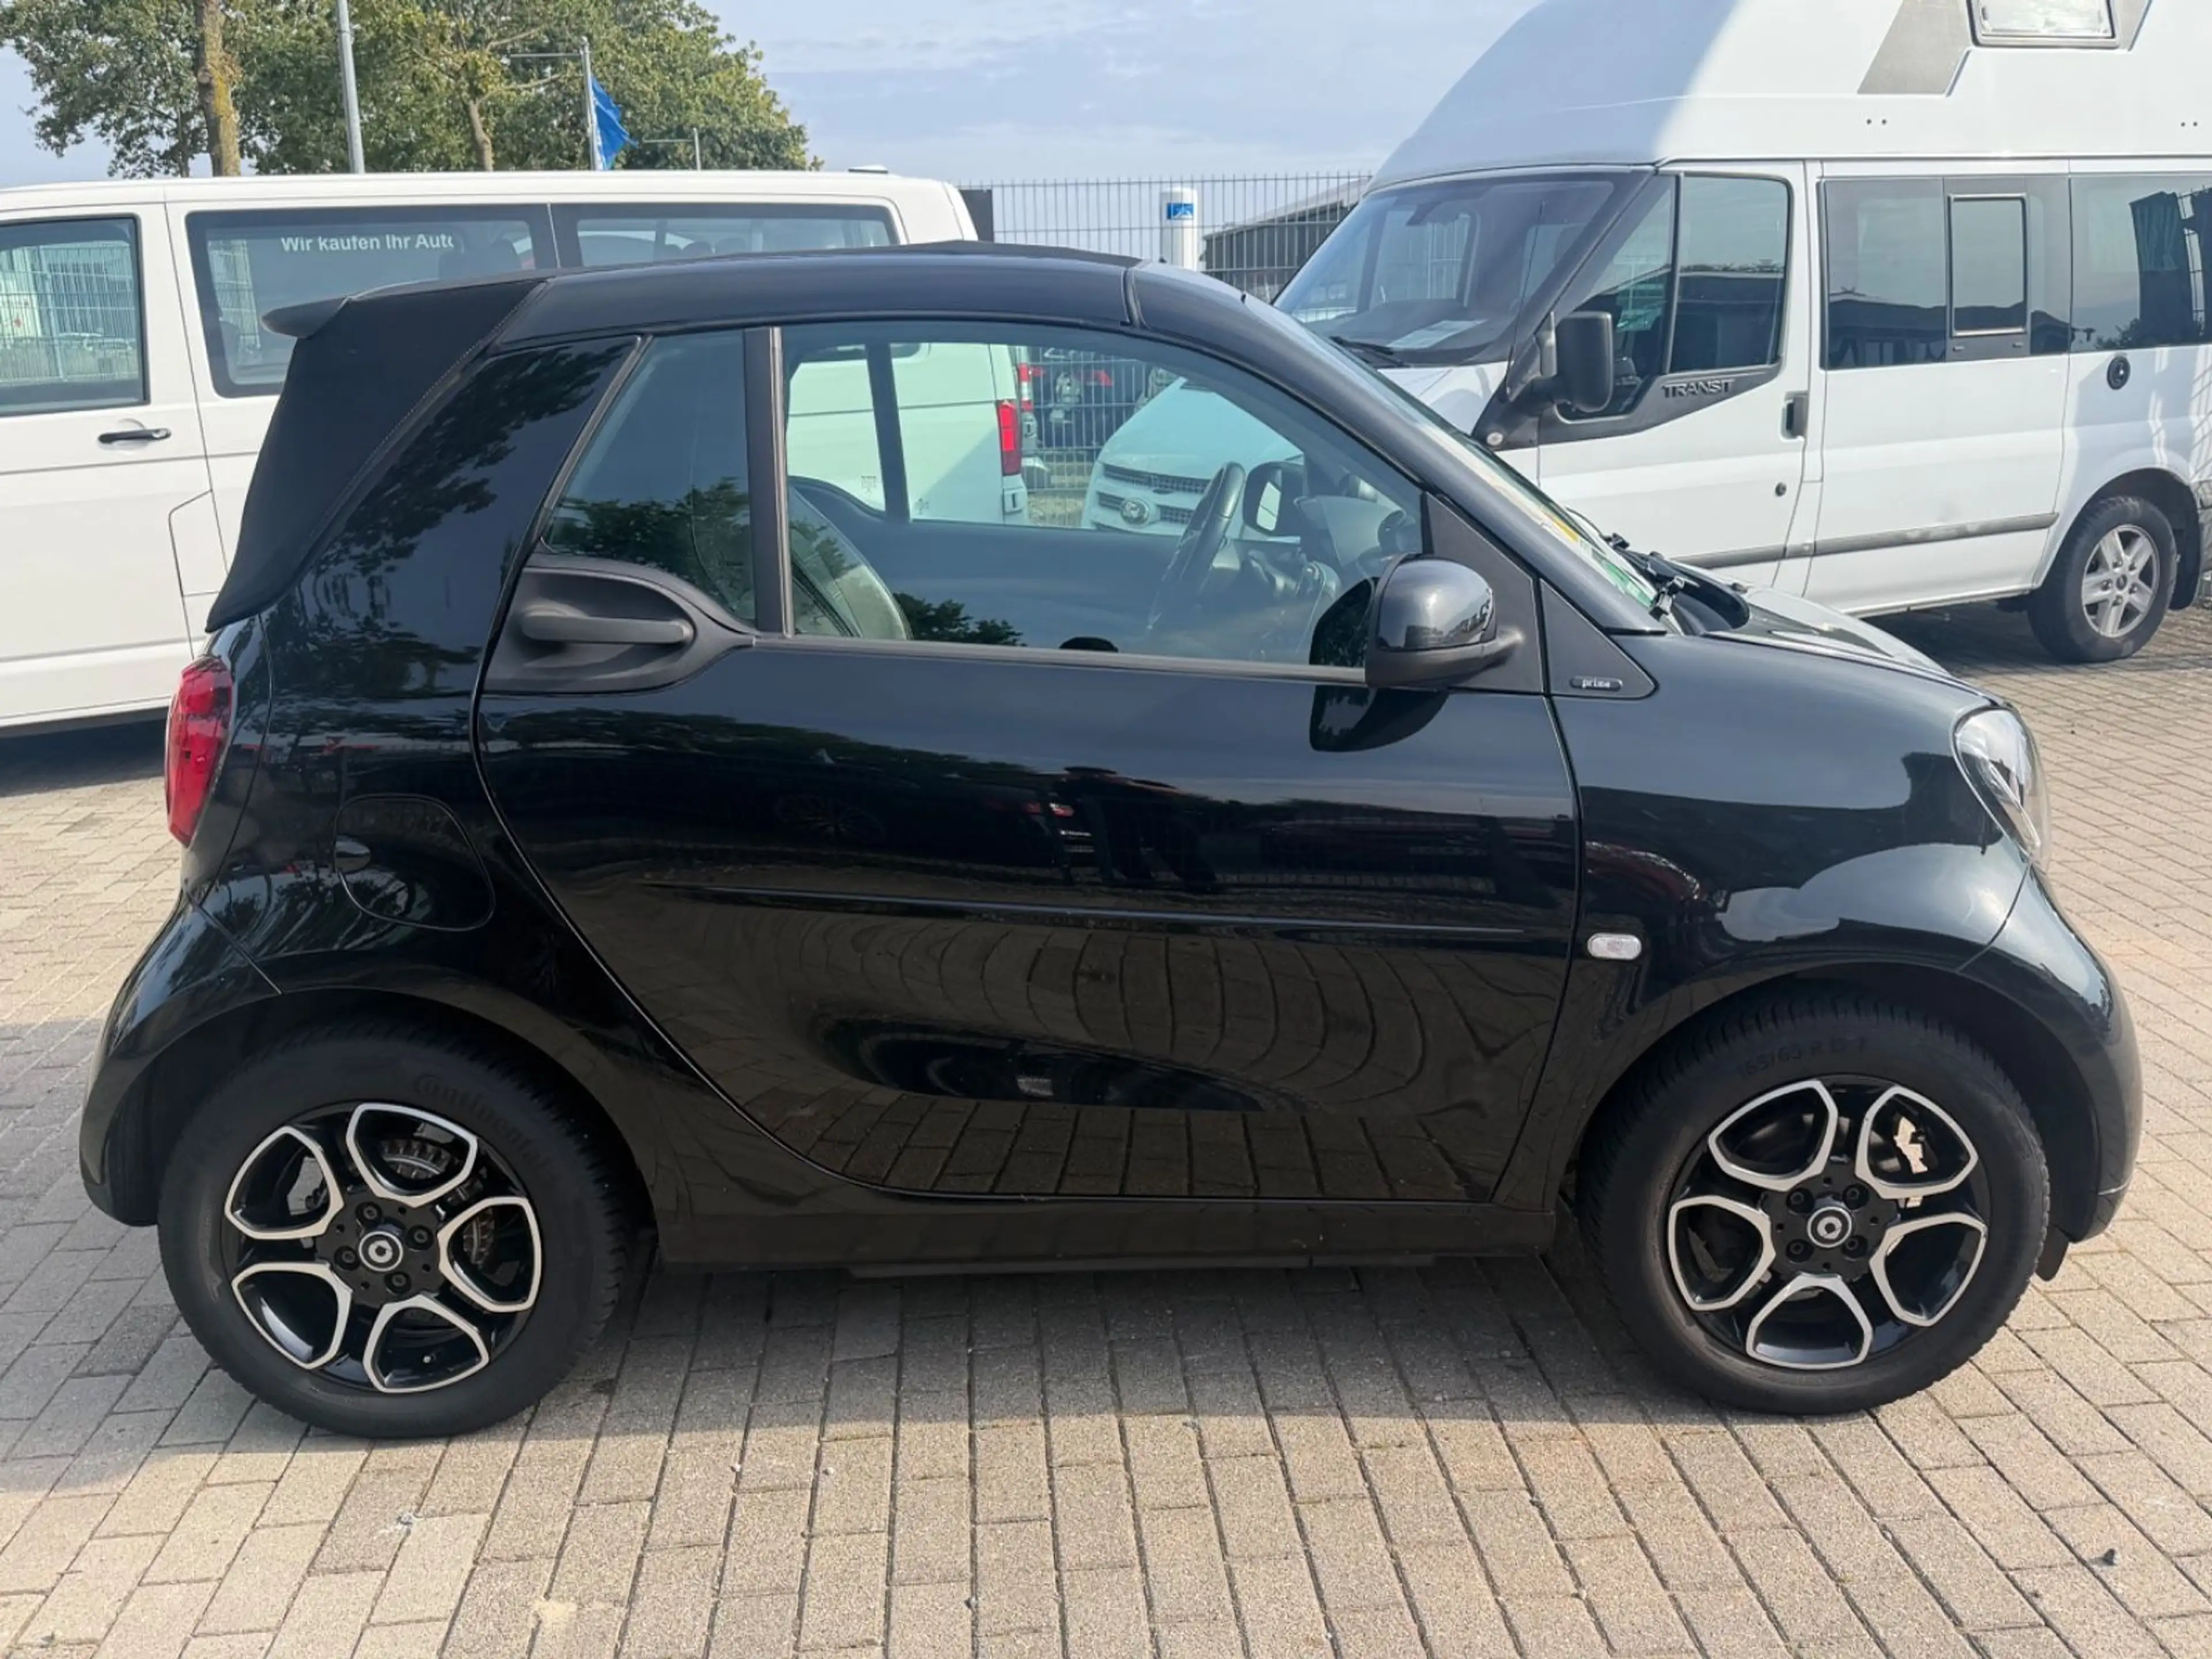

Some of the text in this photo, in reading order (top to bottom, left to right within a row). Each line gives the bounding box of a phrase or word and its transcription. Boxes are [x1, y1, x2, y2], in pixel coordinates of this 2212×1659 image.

[281, 236, 313, 252] Wir
[317, 235, 381, 251] kaufen
[385, 233, 411, 249] Ihr
[1662, 378, 1735, 397] TRANSIT
[1582, 677, 1610, 689] prime
[412, 1072, 554, 1172] Continental
